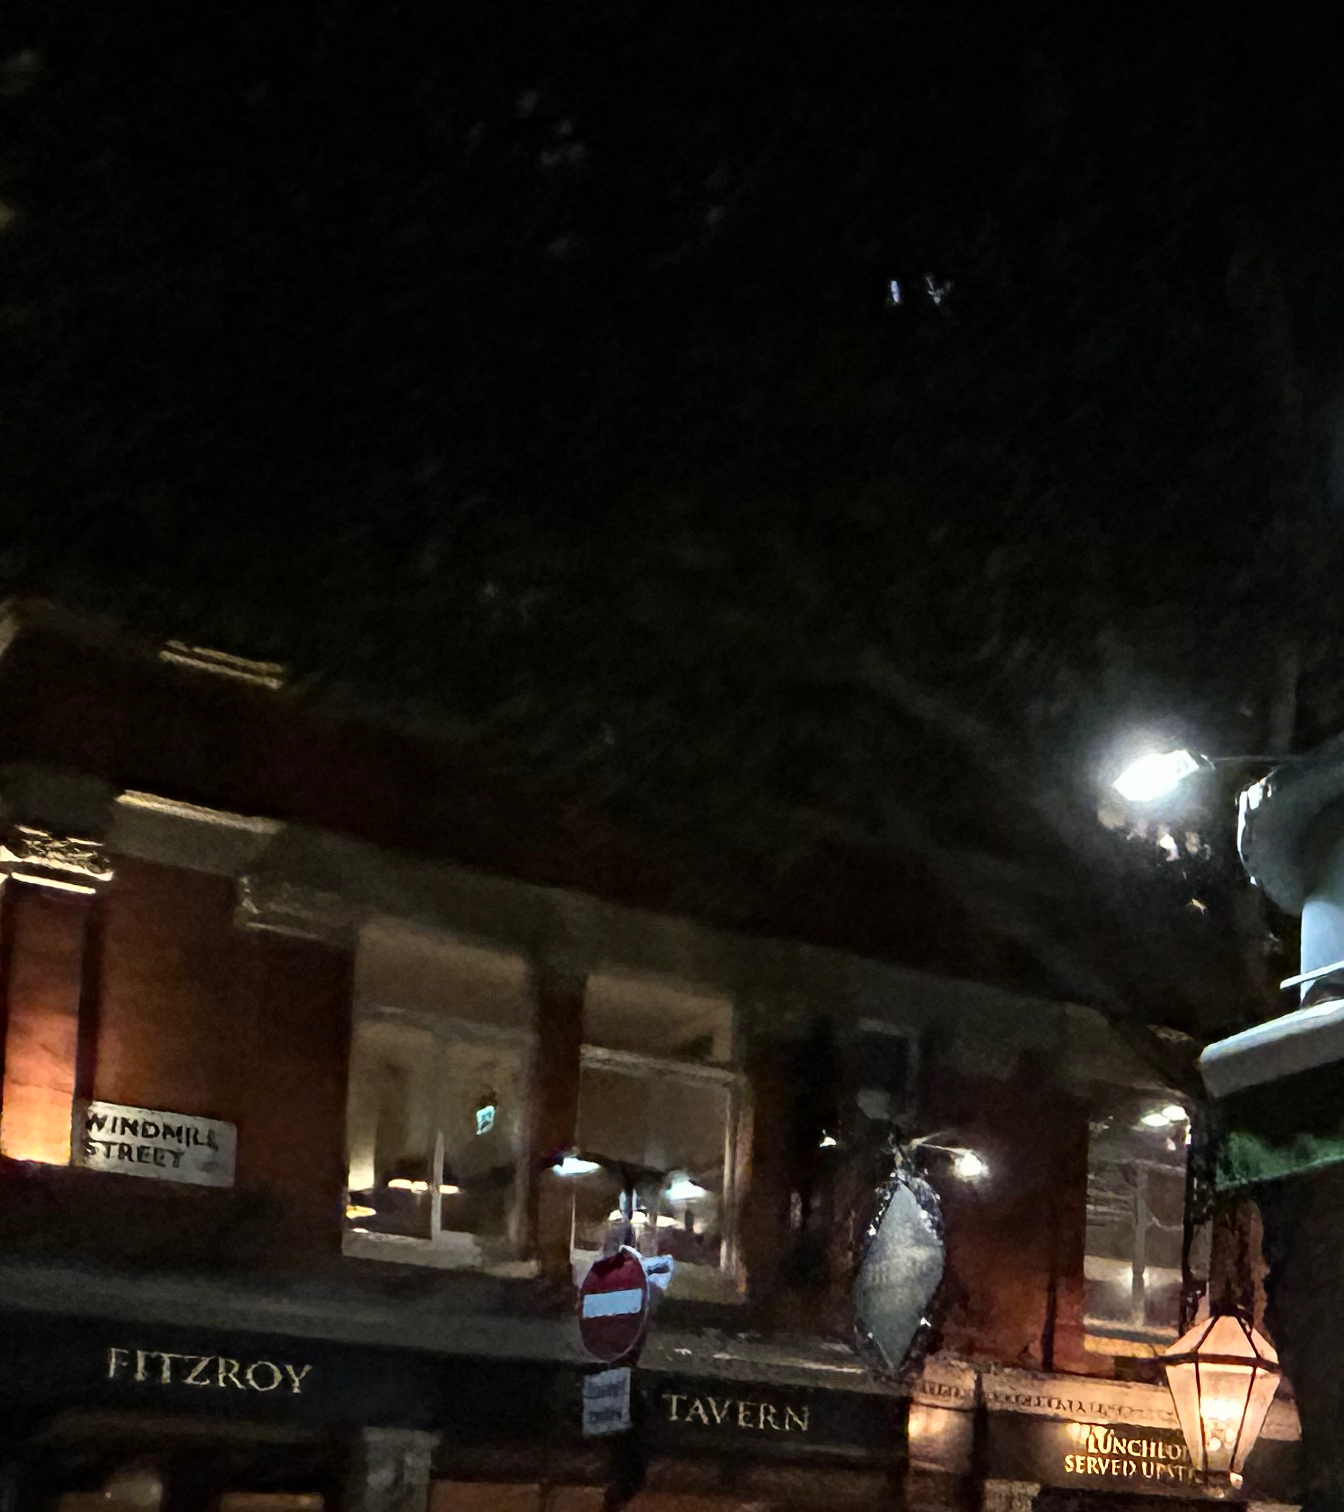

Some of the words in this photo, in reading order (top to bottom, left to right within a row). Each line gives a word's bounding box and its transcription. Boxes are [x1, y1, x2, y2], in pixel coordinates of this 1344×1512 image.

[86, 1112, 219, 1152] WINDMILL
[84, 1138, 184, 1169] STREET
[106, 1347, 313, 1394] FITZROY
[662, 1393, 810, 1432] TAVERN
[1065, 1454, 1137, 1478] SERVED
